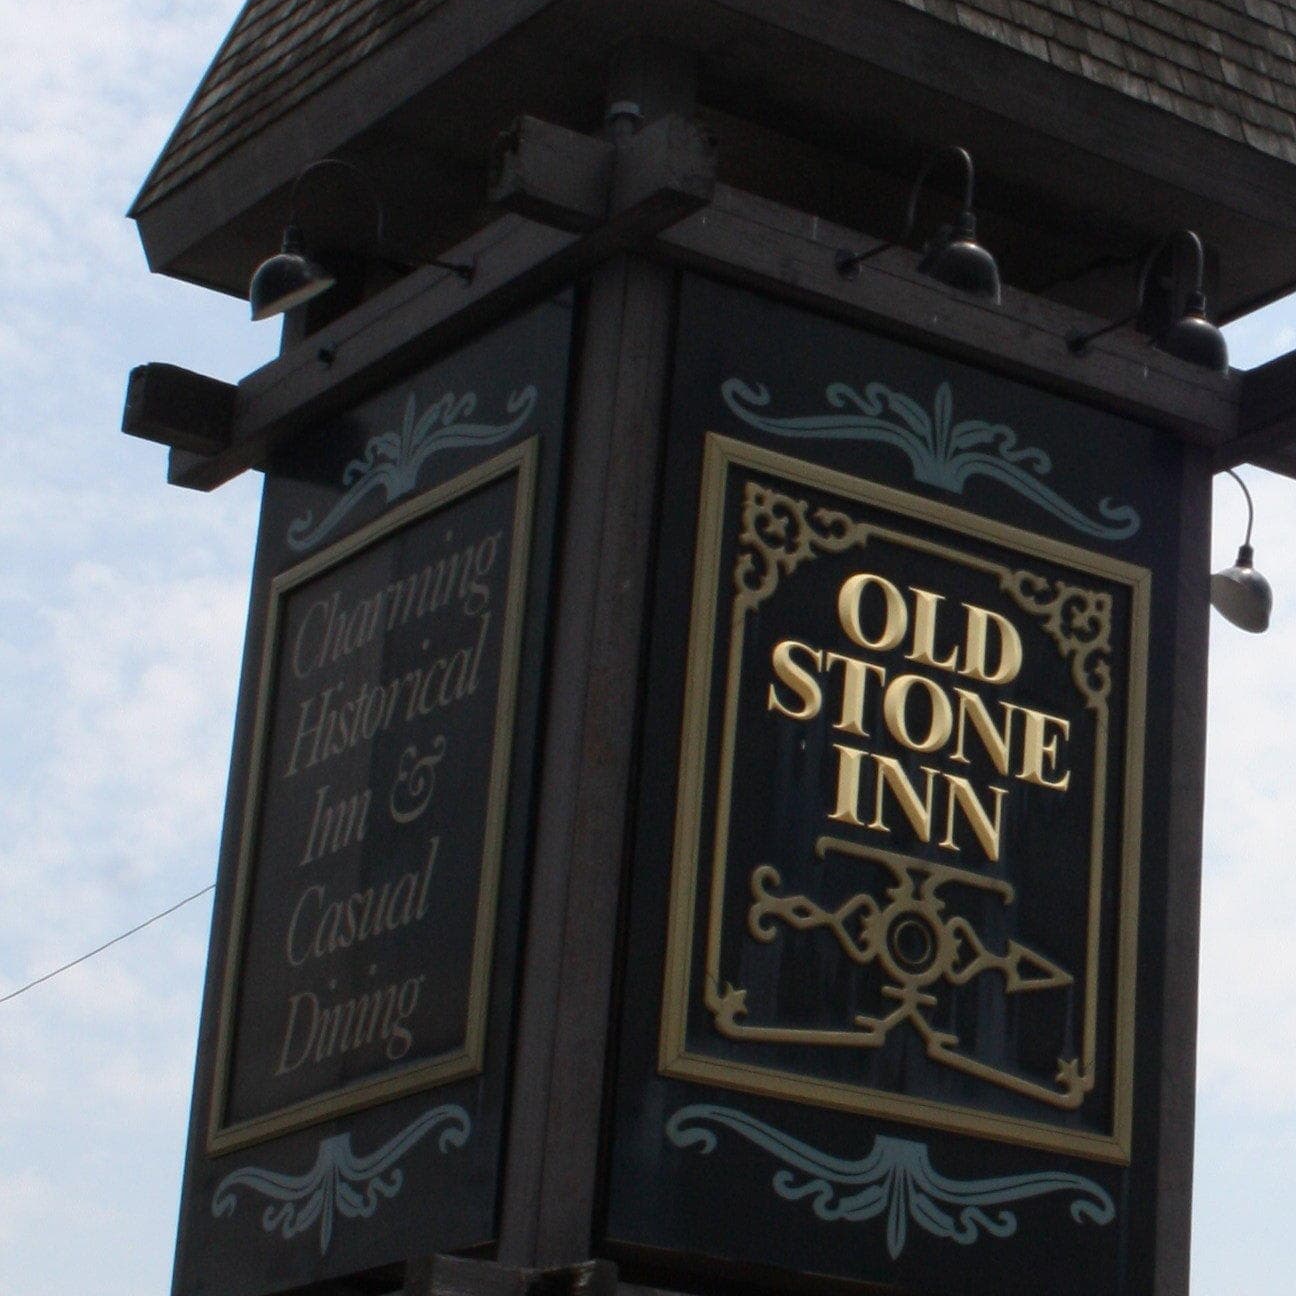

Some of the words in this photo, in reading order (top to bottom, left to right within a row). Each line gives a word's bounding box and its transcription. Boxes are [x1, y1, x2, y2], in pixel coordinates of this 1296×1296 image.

[292, 531, 500, 680] Charming
[837, 573, 1022, 686] OLD
[283, 612, 490, 779] Historical
[767, 640, 1071, 792] STONE
[300, 784, 373, 869] Inn
[389, 734, 445, 824] &
[827, 742, 1008, 862] INN
[285, 836, 438, 967] Casual
[274, 964, 426, 1078] Dining
